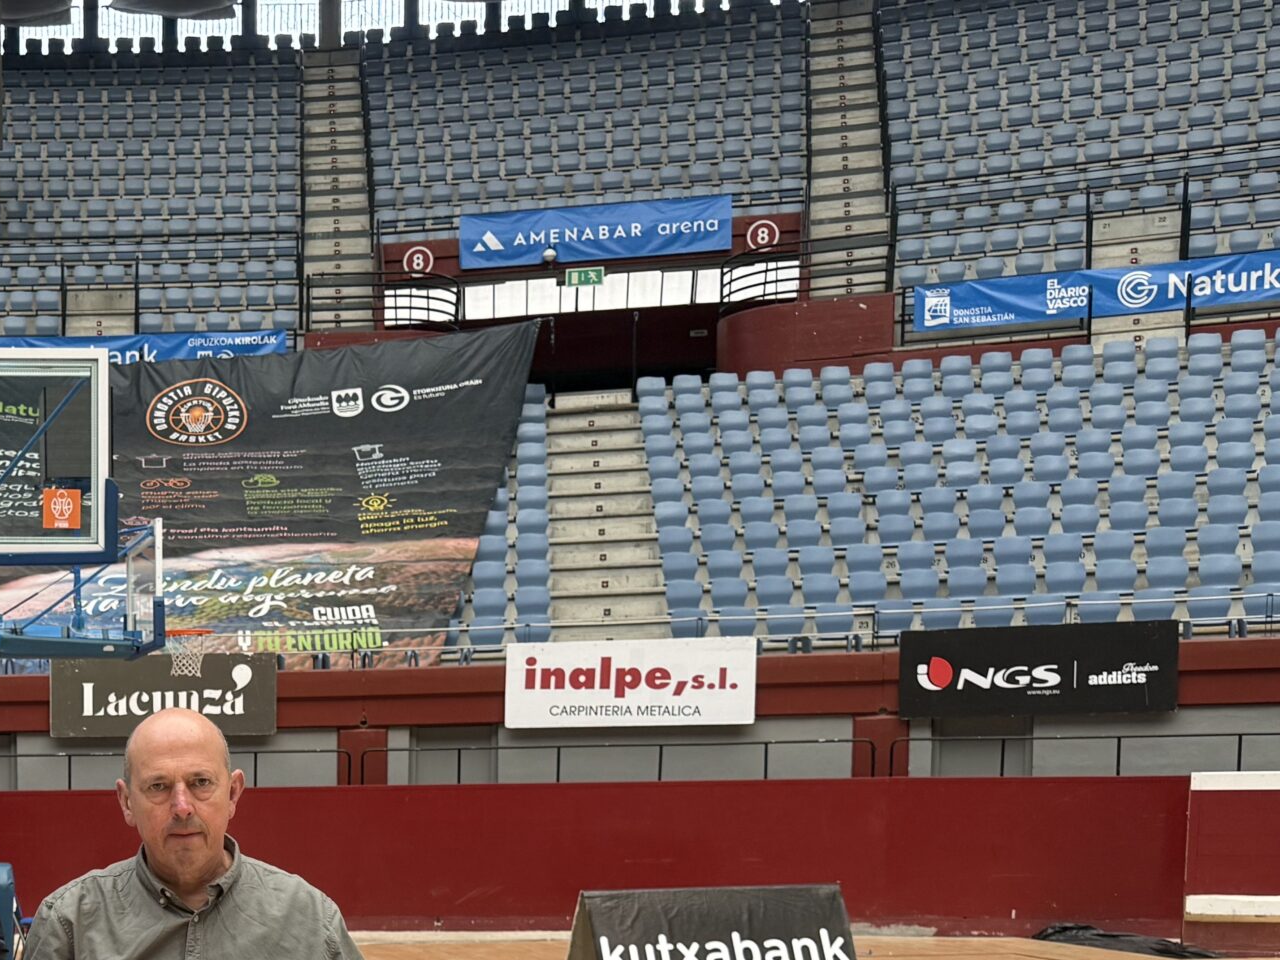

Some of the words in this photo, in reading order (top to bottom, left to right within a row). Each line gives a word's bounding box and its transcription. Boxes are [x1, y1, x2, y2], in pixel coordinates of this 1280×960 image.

[512, 222, 643, 247] AMENABAR
[656, 217, 720, 237] arena
[756, 227, 770, 245] 8
[412, 253, 425, 272] 8
[1046, 279, 1062, 290] EL
[1046, 286, 1089, 300] DIARIO
[952, 306, 993, 317] DONOSTIA
[1046, 297, 1088, 310] VASCO
[952, 315, 971, 325] SAN
[970, 312, 1016, 324] SEBASTIÁN
[187, 336, 234, 347] GIPUZKOA
[234, 334, 277, 346] KIROLAK
[245, 566, 376, 595] planeta
[312, 604, 376, 621] CUIDA
[237, 630, 252, 651] Y
[956, 663, 1062, 691] NGS
[1087, 670, 1148, 687] addicts
[548, 705, 633, 718] CARPINTERIA
[635, 704, 702, 717] METALICA
